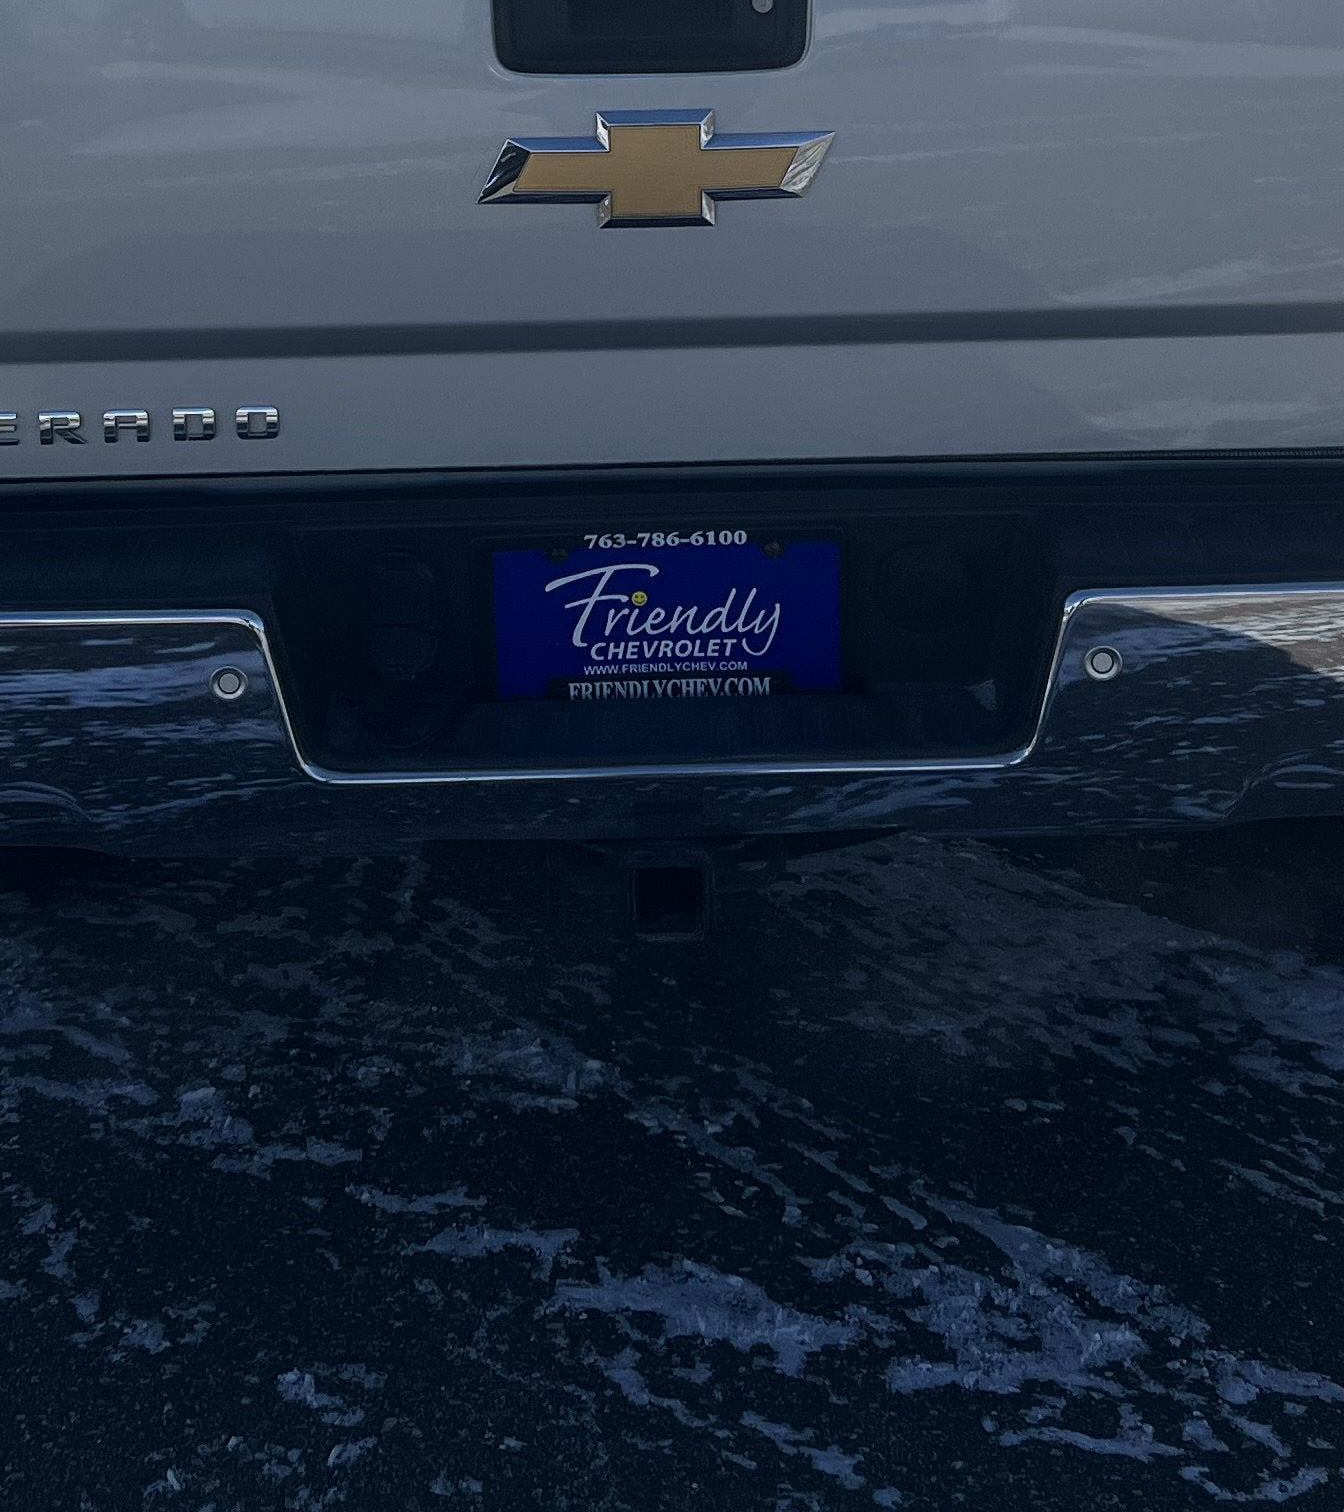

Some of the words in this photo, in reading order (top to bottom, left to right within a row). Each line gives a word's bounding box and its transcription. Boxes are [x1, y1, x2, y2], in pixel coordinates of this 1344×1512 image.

[583, 530, 748, 550] 763-786-6100
[544, 563, 781, 656] Friendly
[590, 638, 738, 661] CHEVROLET
[583, 660, 748, 676] WWW.FRIENDLYCHEV.COM
[567, 676, 772, 701] FRIENDLYCHEV.COM
